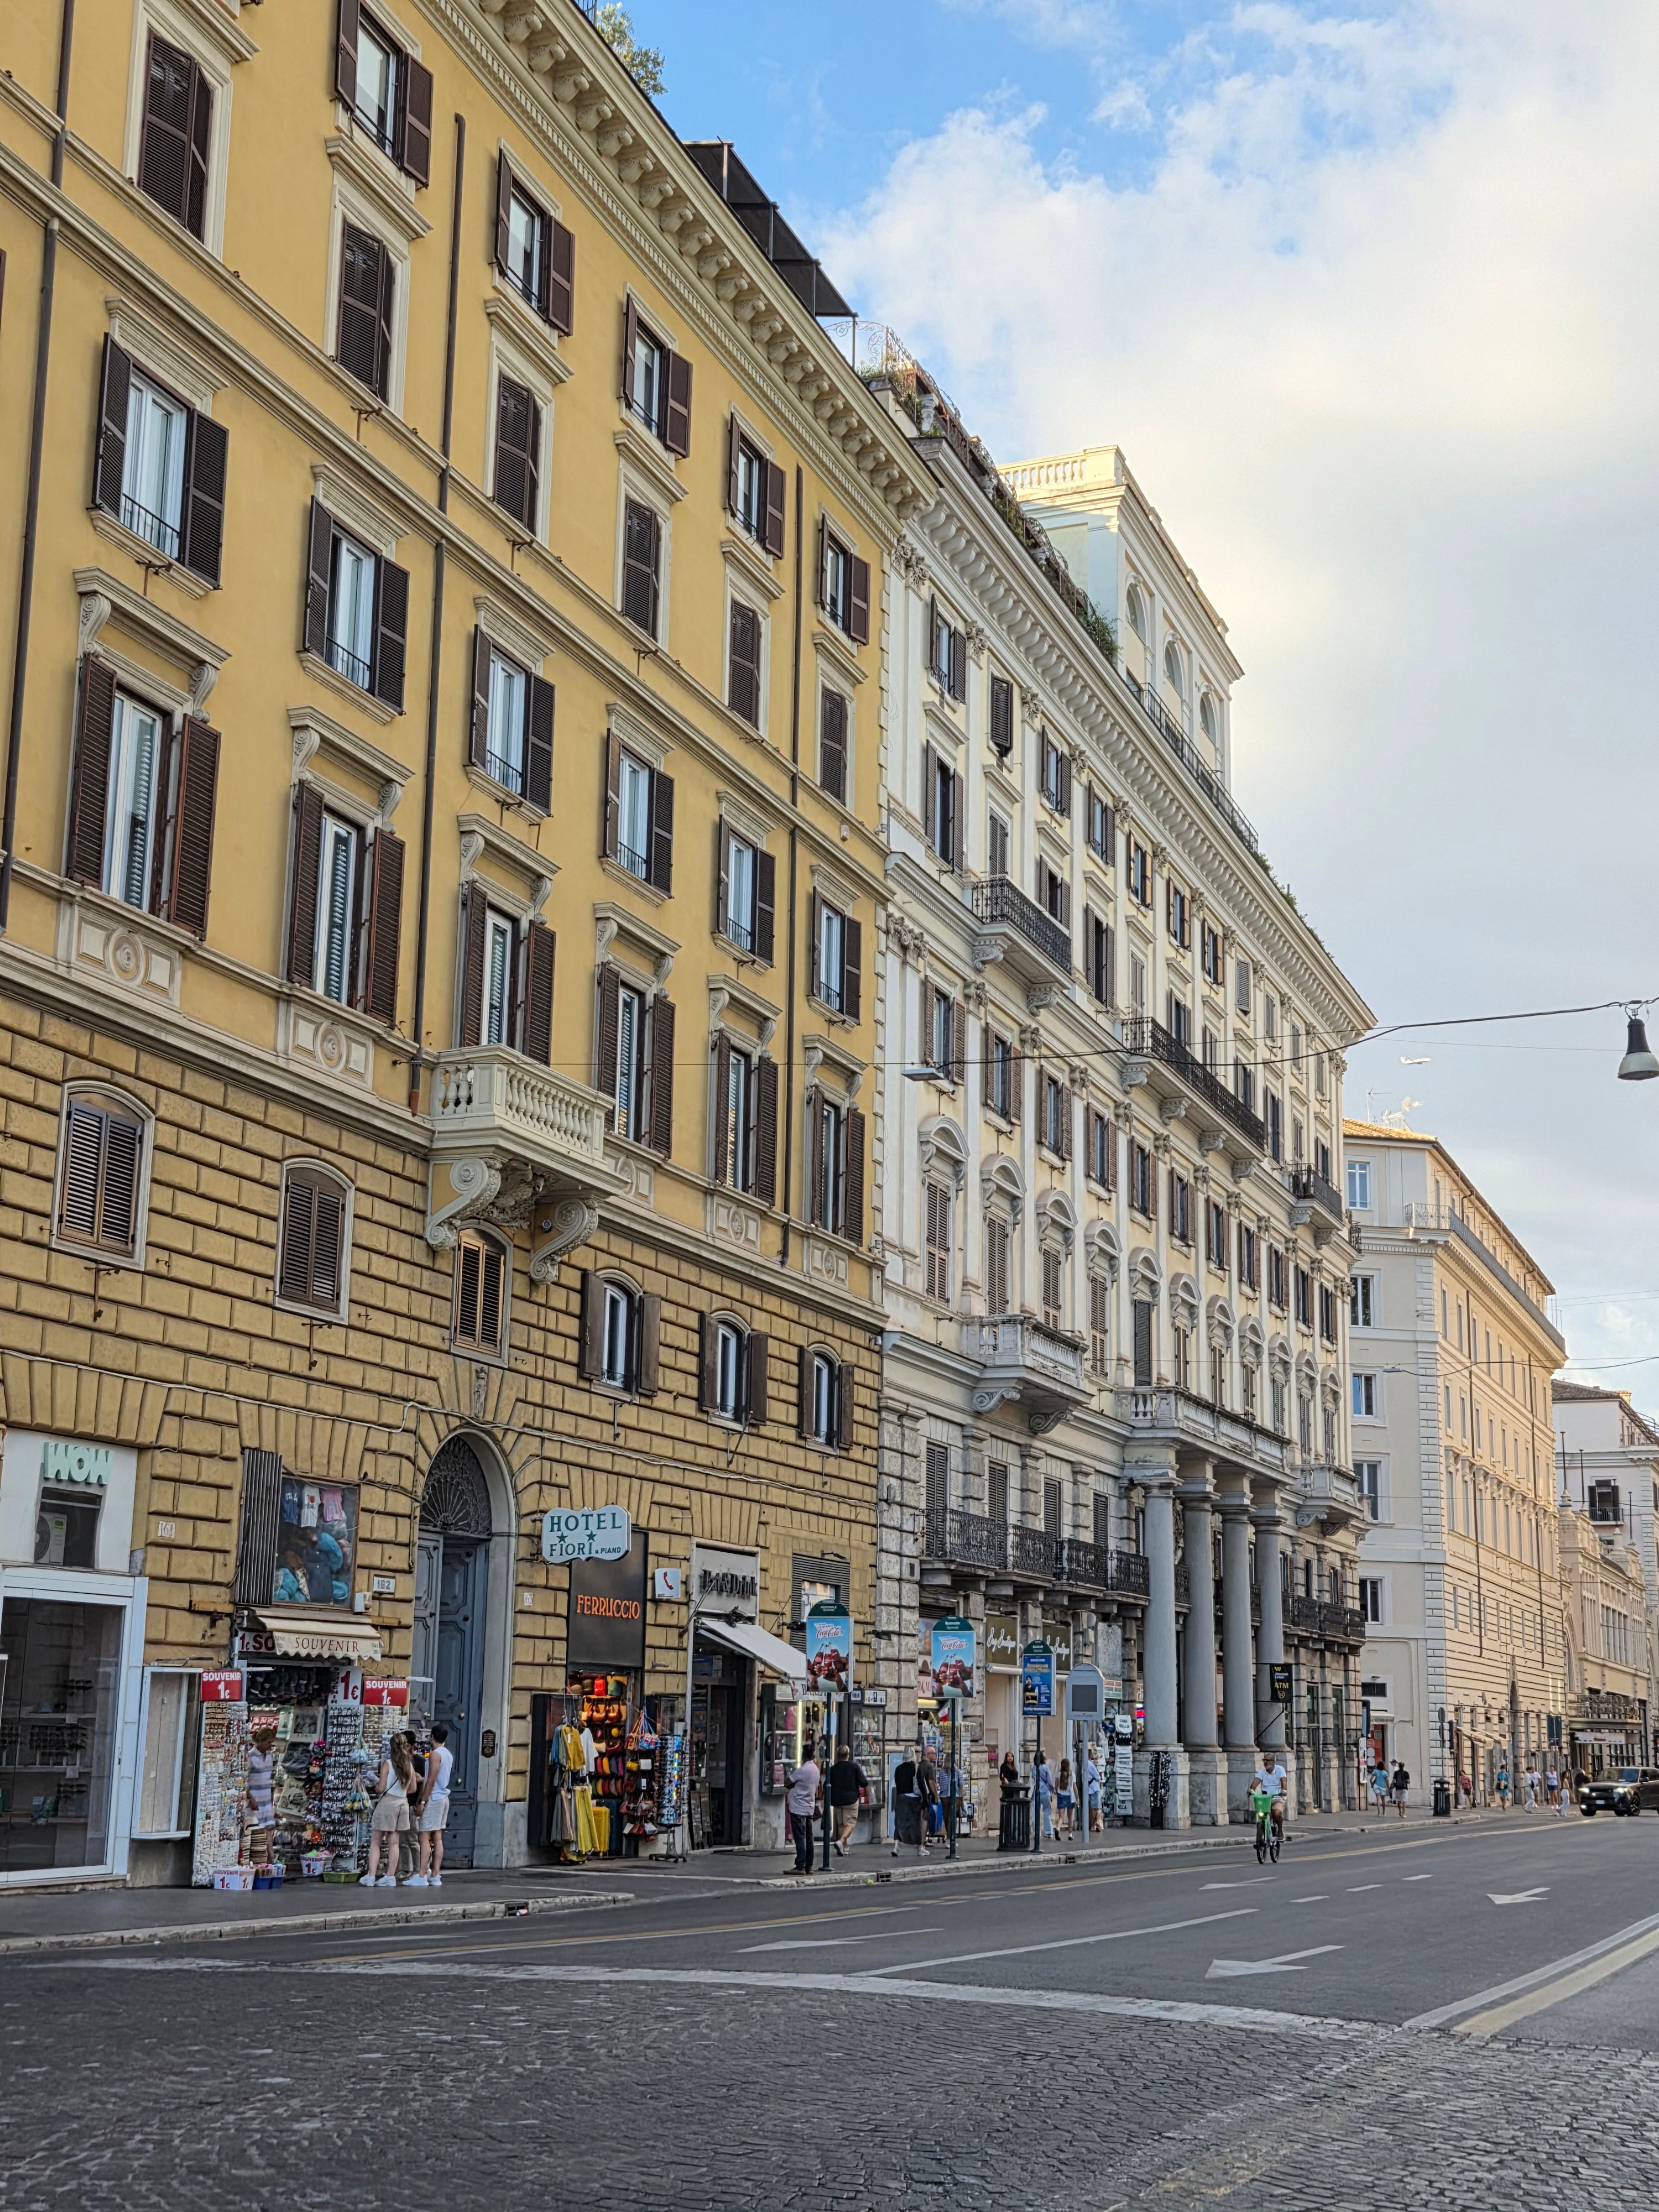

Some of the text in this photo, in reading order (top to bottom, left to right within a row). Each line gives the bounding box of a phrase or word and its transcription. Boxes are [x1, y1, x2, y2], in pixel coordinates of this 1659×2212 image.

[44, 1442, 114, 1485] WOW
[549, 1512, 622, 1532] HOTEL
[549, 1542, 593, 1556] FIORI
[377, 1579, 390, 1590] 162
[576, 1594, 640, 1619] FERRUCCIO
[295, 1637, 359, 1652] SOUVENIR
[202, 1672, 242, 1681] SOUVENIR
[341, 1671, 359, 1700] 1€
[366, 1681, 407, 1689] SOUVENIR
